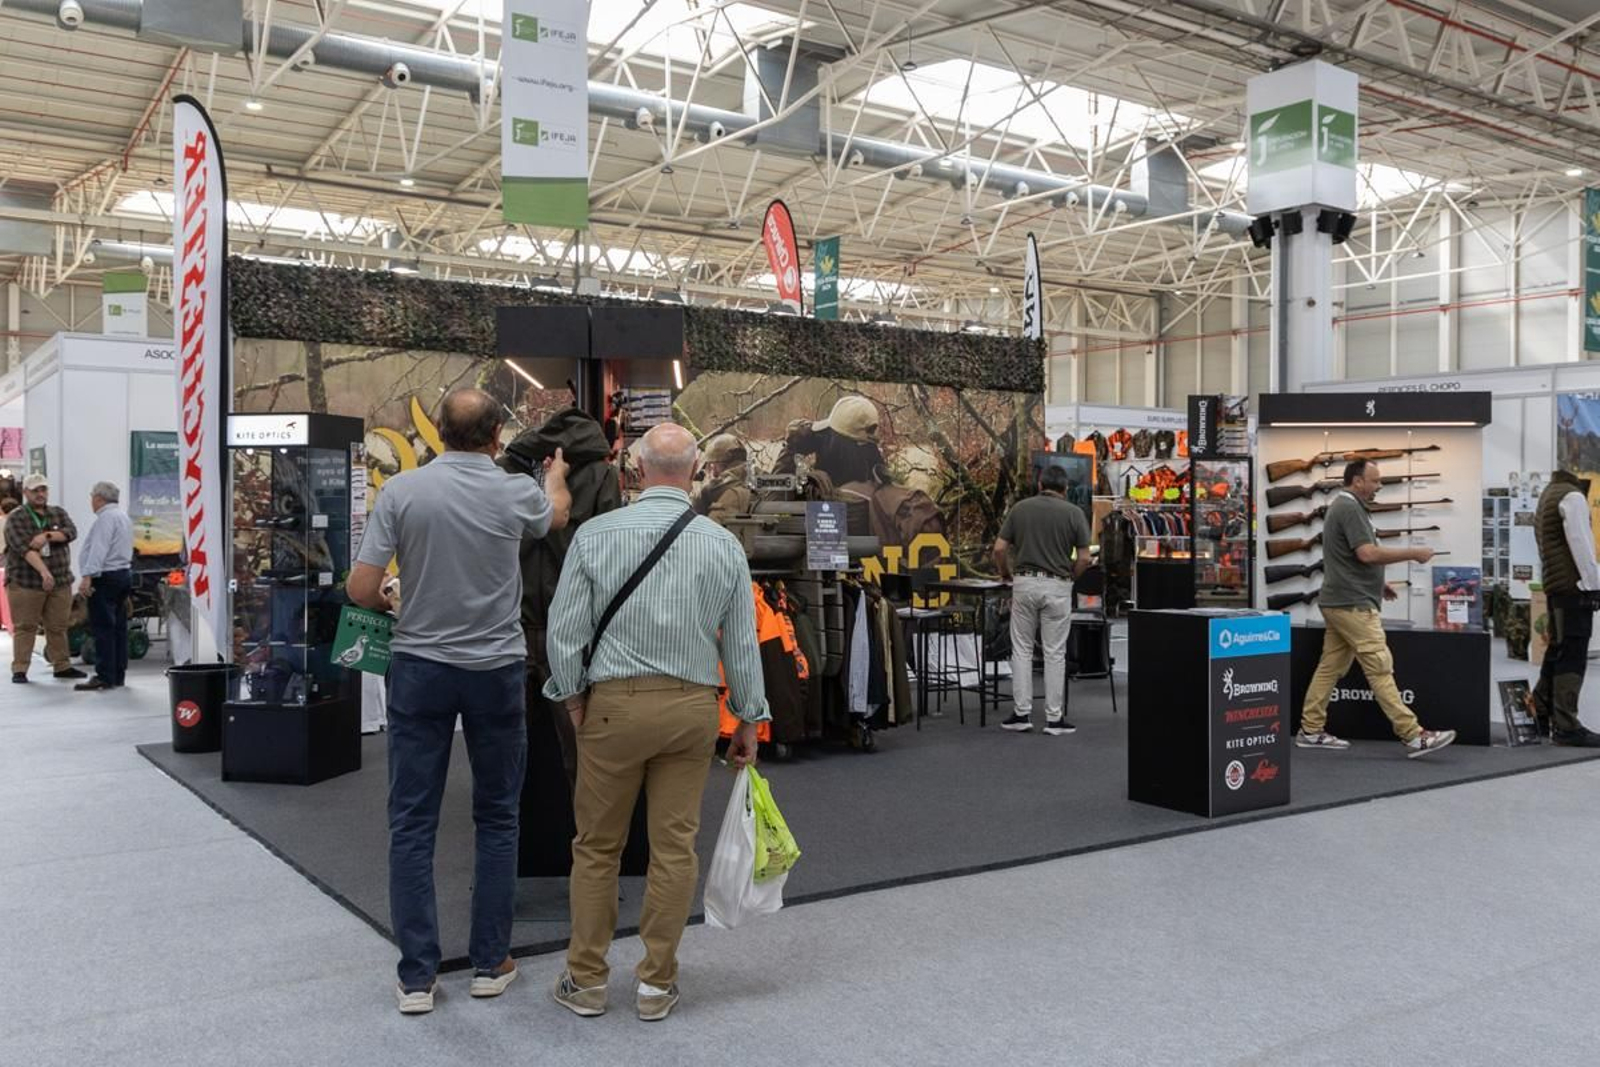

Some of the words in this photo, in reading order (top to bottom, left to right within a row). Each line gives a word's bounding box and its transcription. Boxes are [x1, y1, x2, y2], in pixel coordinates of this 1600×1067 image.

[550, 29, 577, 41] IFEJA
[550, 131, 577, 143] IFEJA
[236, 431, 256, 440] KITE
[259, 431, 292, 440] OPTICS
[1233, 680, 1279, 697] BROWNING
[1330, 687, 1415, 705] BROWG
[1225, 704, 1279, 723] WINCHESTER
[1226, 738, 1245, 749] KITE
[1246, 734, 1276, 747] OPTICS
